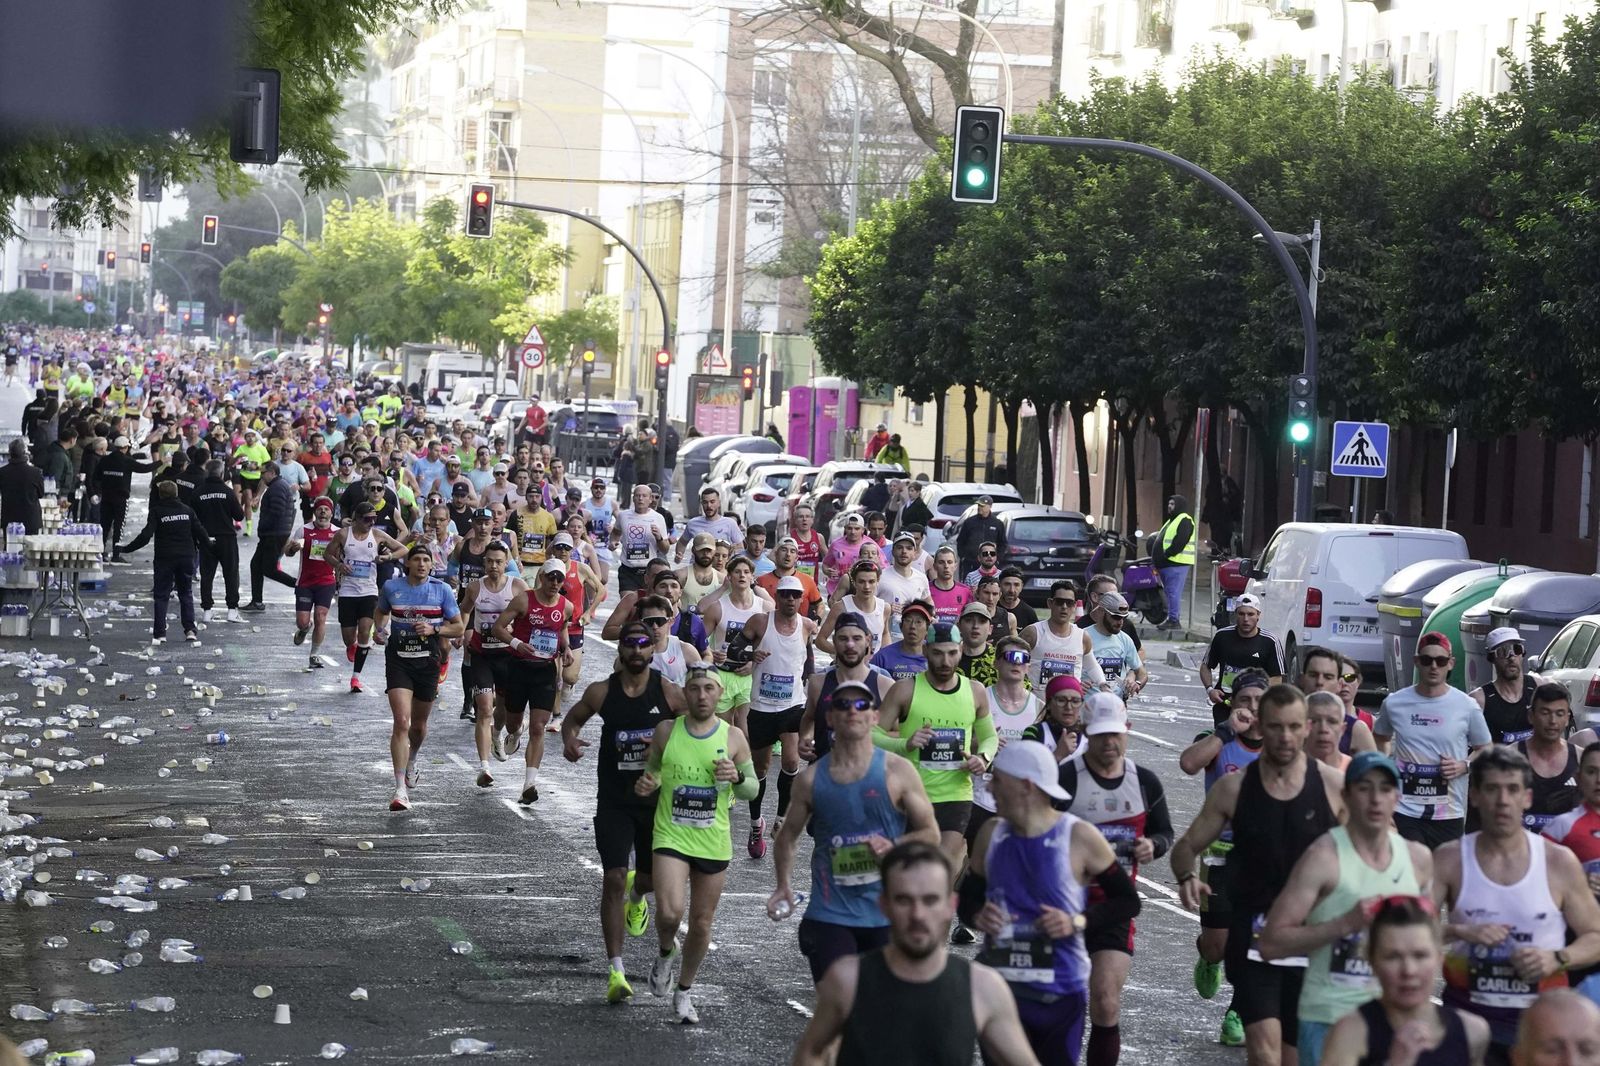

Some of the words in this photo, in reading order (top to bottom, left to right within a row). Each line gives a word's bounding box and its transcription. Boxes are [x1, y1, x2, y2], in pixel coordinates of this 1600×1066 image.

[526, 353, 540, 361] 30
[161, 514, 190, 523] VOLUNTEER
[593, 519, 604, 531] 13
[1338, 624, 1361, 633] 9177
[1362, 625, 1380, 635] MFY
[404, 644, 422, 652] RAPH
[1043, 651, 1077, 661] MASSIMO
[772, 675, 793, 683] ZURICH
[760, 688, 793, 698] MONCLOVA
[931, 751, 955, 761] CAST
[1413, 786, 1437, 795] JOAN
[1008, 953, 1033, 967] FER
[1476, 977, 1531, 993] CARLOS
